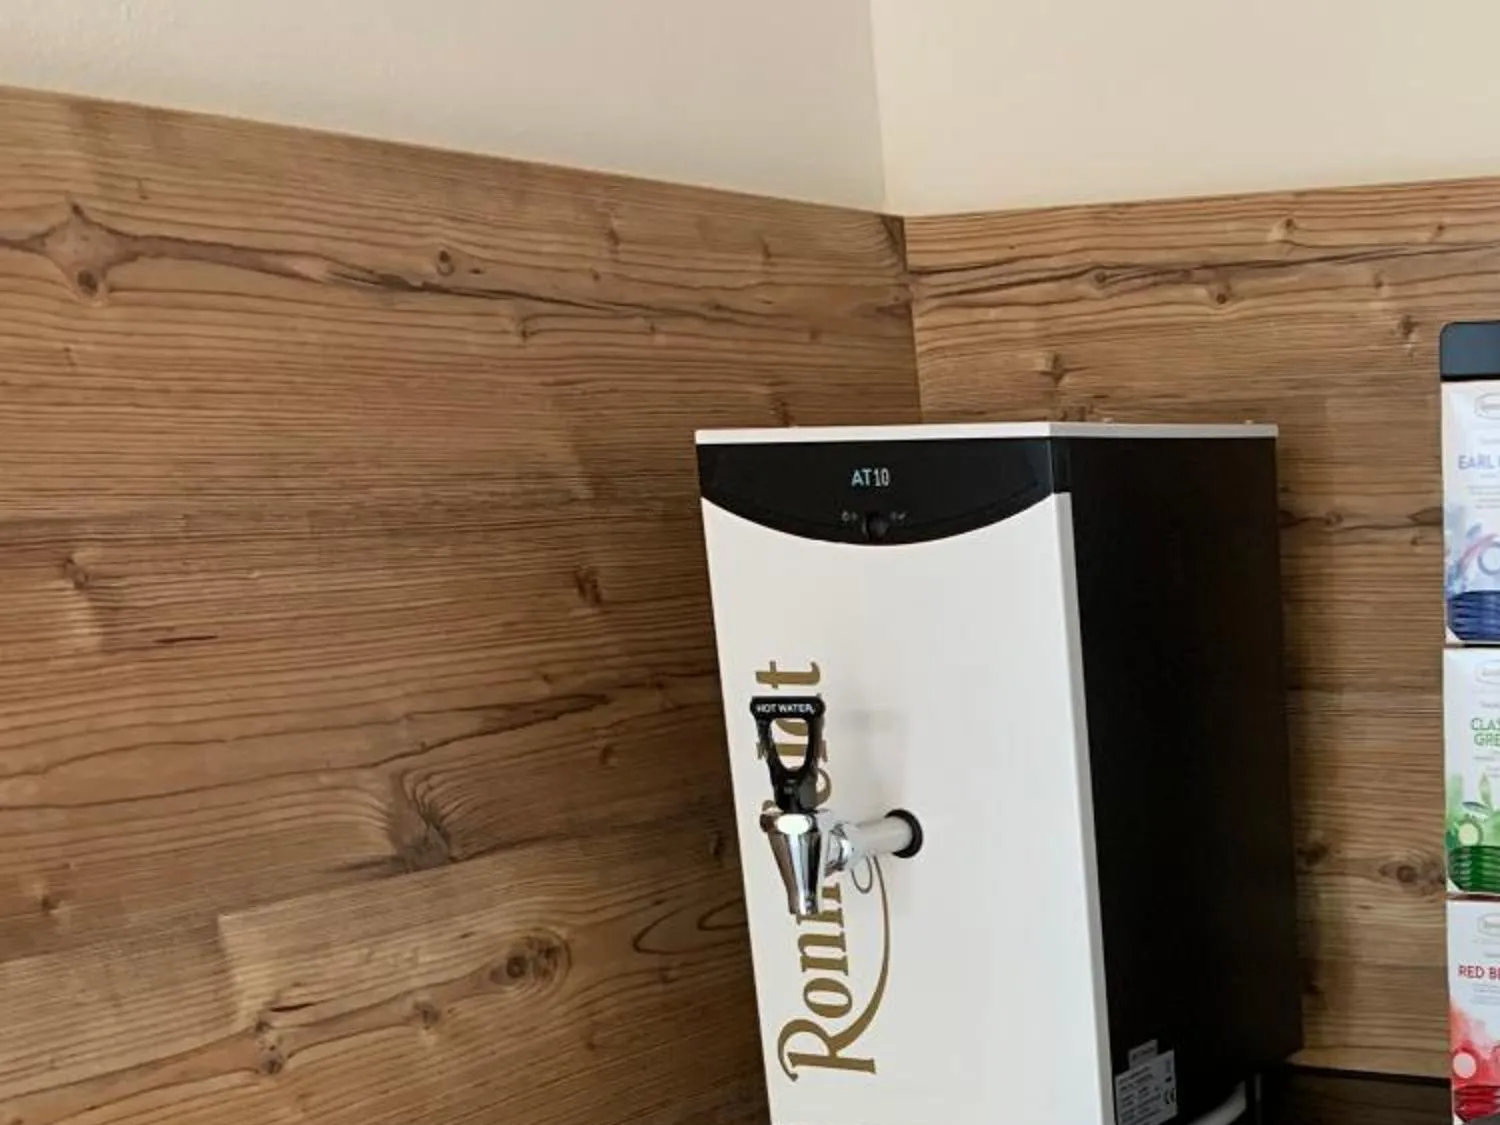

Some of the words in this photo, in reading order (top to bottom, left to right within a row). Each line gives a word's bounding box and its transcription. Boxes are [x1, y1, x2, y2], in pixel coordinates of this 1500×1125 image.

[1458, 453, 1494, 470] EARL
[851, 467, 891, 487] AT10
[756, 703, 776, 713] HOT
[778, 703, 813, 714] WATER
[1457, 964, 1485, 979] RED
